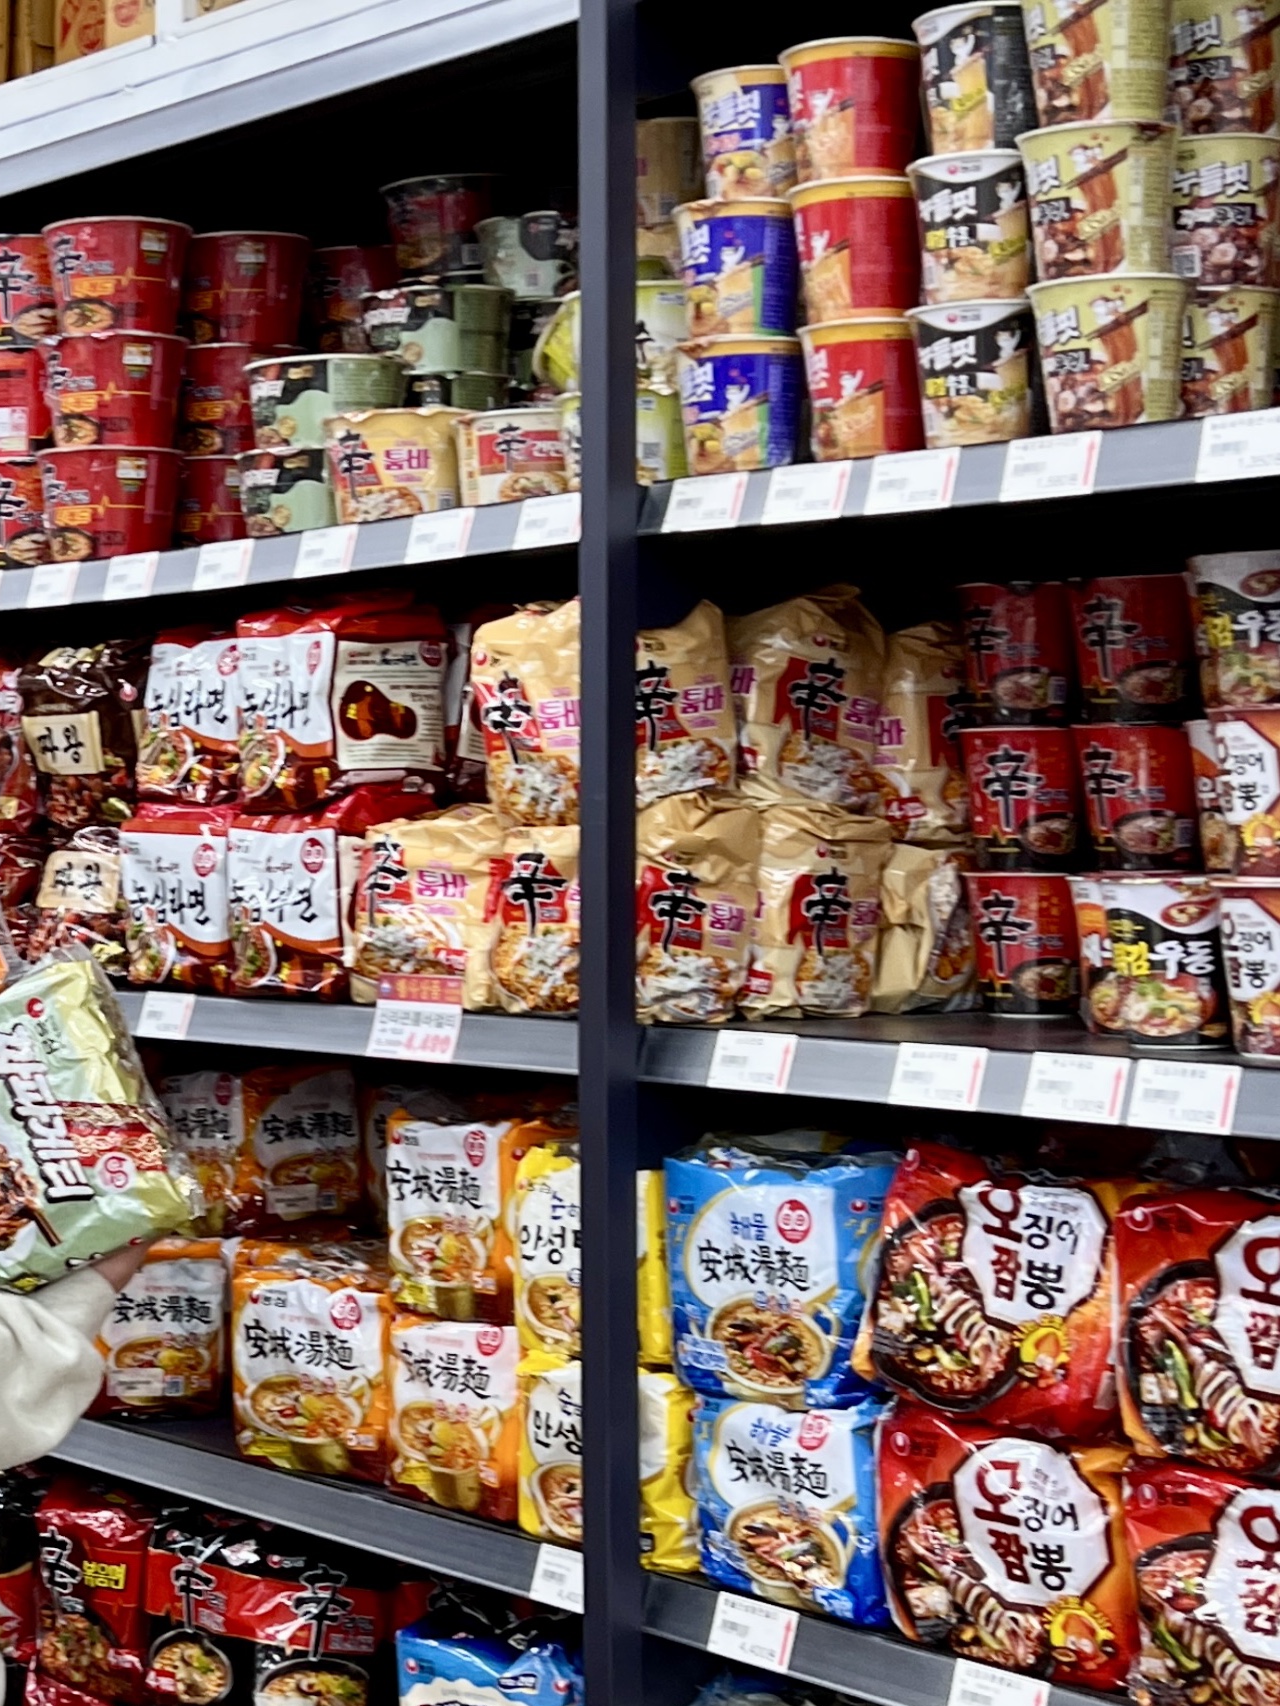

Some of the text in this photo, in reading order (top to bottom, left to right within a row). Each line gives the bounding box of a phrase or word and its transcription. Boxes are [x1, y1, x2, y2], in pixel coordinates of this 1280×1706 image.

[1173, 161, 1250, 197] 누들핏
[337, 428, 375, 503] 辛
[383, 448, 432, 471] 툼바
[495, 422, 528, 475] 辛
[1081, 593, 1142, 683] 辛
[148, 678, 229, 729] 농심라면
[634, 658, 679, 752] 辛
[680, 684, 724, 716] 툼바
[729, 664, 758, 698] 바
[788, 656, 849, 743] 辛
[482, 671, 533, 765] 辛
[981, 743, 1046, 833] 辛
[1082, 741, 1134, 832] 辛
[129, 878, 211, 926] 농심라면
[364, 833, 408, 928] 辛
[416, 868, 469, 900] 툼바
[502, 842, 568, 938] 辛
[648, 870, 708, 955] 辛
[801, 866, 853, 956] 辛
[708, 901, 746, 934] 툼바
[978, 889, 1036, 978] 辛
[386, 1158, 484, 1210] 安城湯麵
[730, 1212, 769, 1242] 해물
[977, 1186, 1083, 1255] 오징어
[697, 1240, 811, 1292] 安城湯麵
[989, 1244, 1066, 1310] 짬뽕
[112, 1293, 215, 1326] 安城湯麵
[242, 1318, 360, 1372] 安城湯麵
[974, 1459, 1080, 1533] 오징어
[38, 1525, 84, 1616] 辛
[987, 1527, 1072, 1593] 짬뽕
[292, 1563, 355, 1662] 辛
